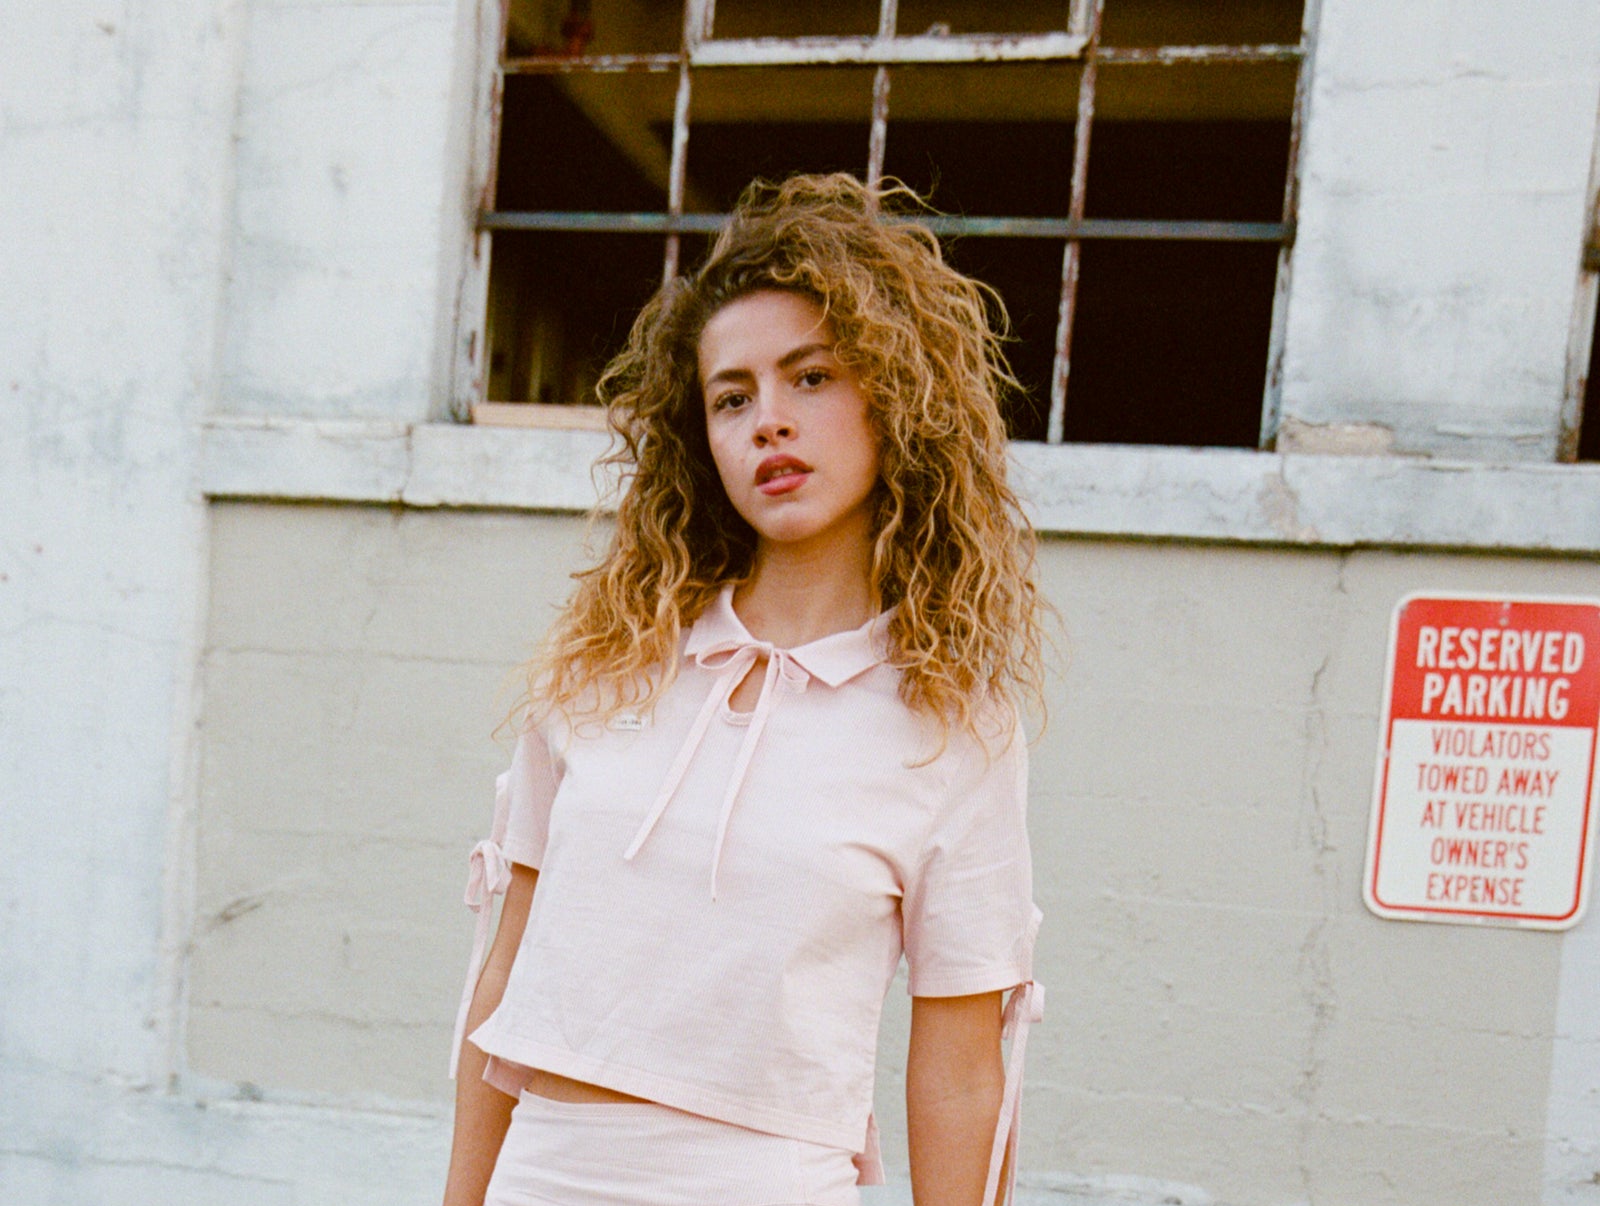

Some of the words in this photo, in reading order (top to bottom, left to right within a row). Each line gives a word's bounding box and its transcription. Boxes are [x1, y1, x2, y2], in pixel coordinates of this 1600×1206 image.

[1417, 627, 1584, 673] RESERVED
[1422, 675, 1569, 719] PARKING
[1432, 729, 1551, 760] VIOLATORS
[1418, 765, 1488, 795] TOWED
[1498, 770, 1559, 798] AWAY
[1421, 801, 1447, 828] AT
[1455, 804, 1546, 835] VEHICLE
[1431, 838, 1529, 870] OWNER'S
[1427, 874, 1523, 906] EXPENSE
